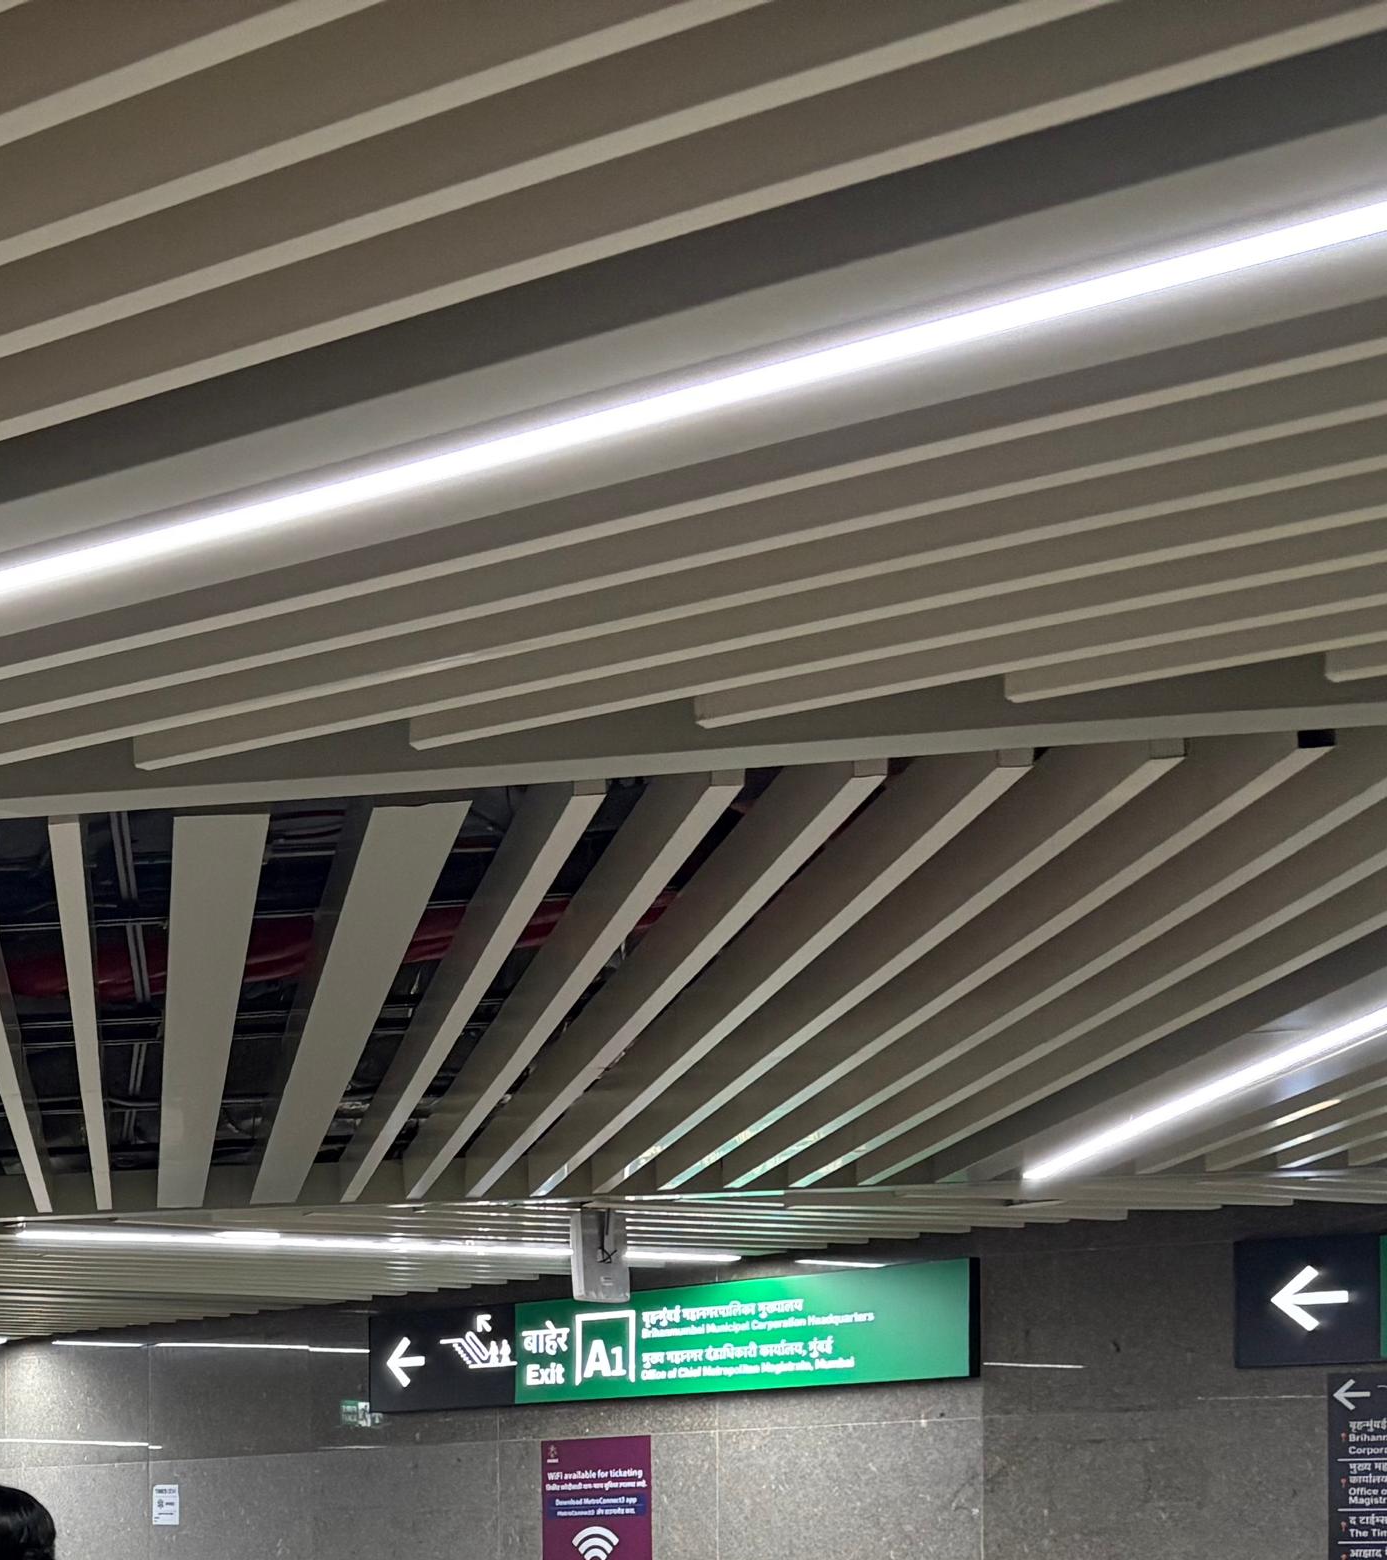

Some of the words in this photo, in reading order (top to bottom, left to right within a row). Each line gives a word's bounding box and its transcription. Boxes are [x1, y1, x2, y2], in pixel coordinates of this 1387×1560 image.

[521, 1320, 570, 1356] बाहेर
[583, 1339, 627, 1378] A1
[526, 1362, 565, 1386] Exit
[1349, 1433, 1387, 1442] Brihan
[1349, 1446, 1387, 1456] Corpor
[564, 1470, 596, 1480] available
[597, 1469, 608, 1478] for
[609, 1468, 643, 1480] ticketing
[1349, 1496, 1387, 1508] Magistr
[1349, 1528, 1369, 1538] The
[1371, 1528, 1387, 1538] Tim
